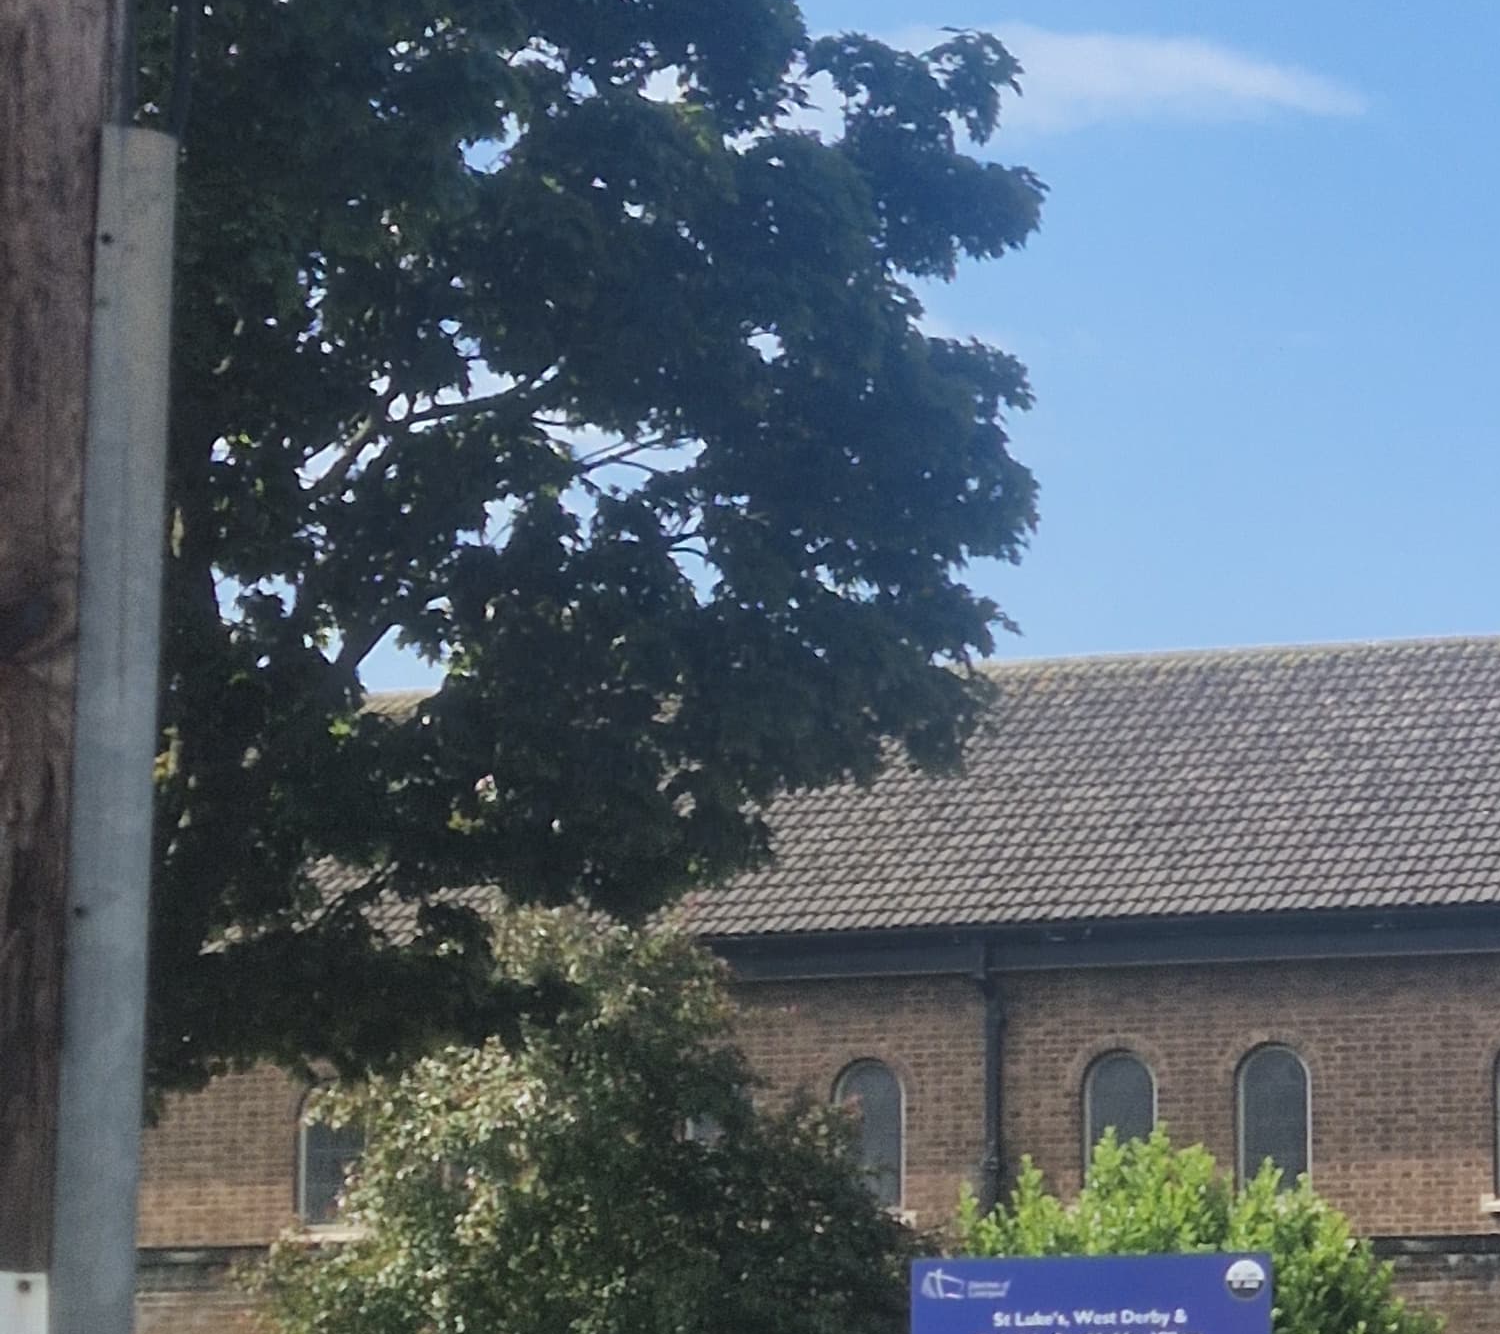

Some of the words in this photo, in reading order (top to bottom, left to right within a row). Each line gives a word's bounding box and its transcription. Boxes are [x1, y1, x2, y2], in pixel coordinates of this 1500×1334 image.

[993, 1311, 1011, 1327] St
[1014, 1310, 1070, 1327] Luke's,
[1072, 1310, 1117, 1325] West
[1120, 1308, 1170, 1327] Derby
[1173, 1308, 1188, 1323] &
